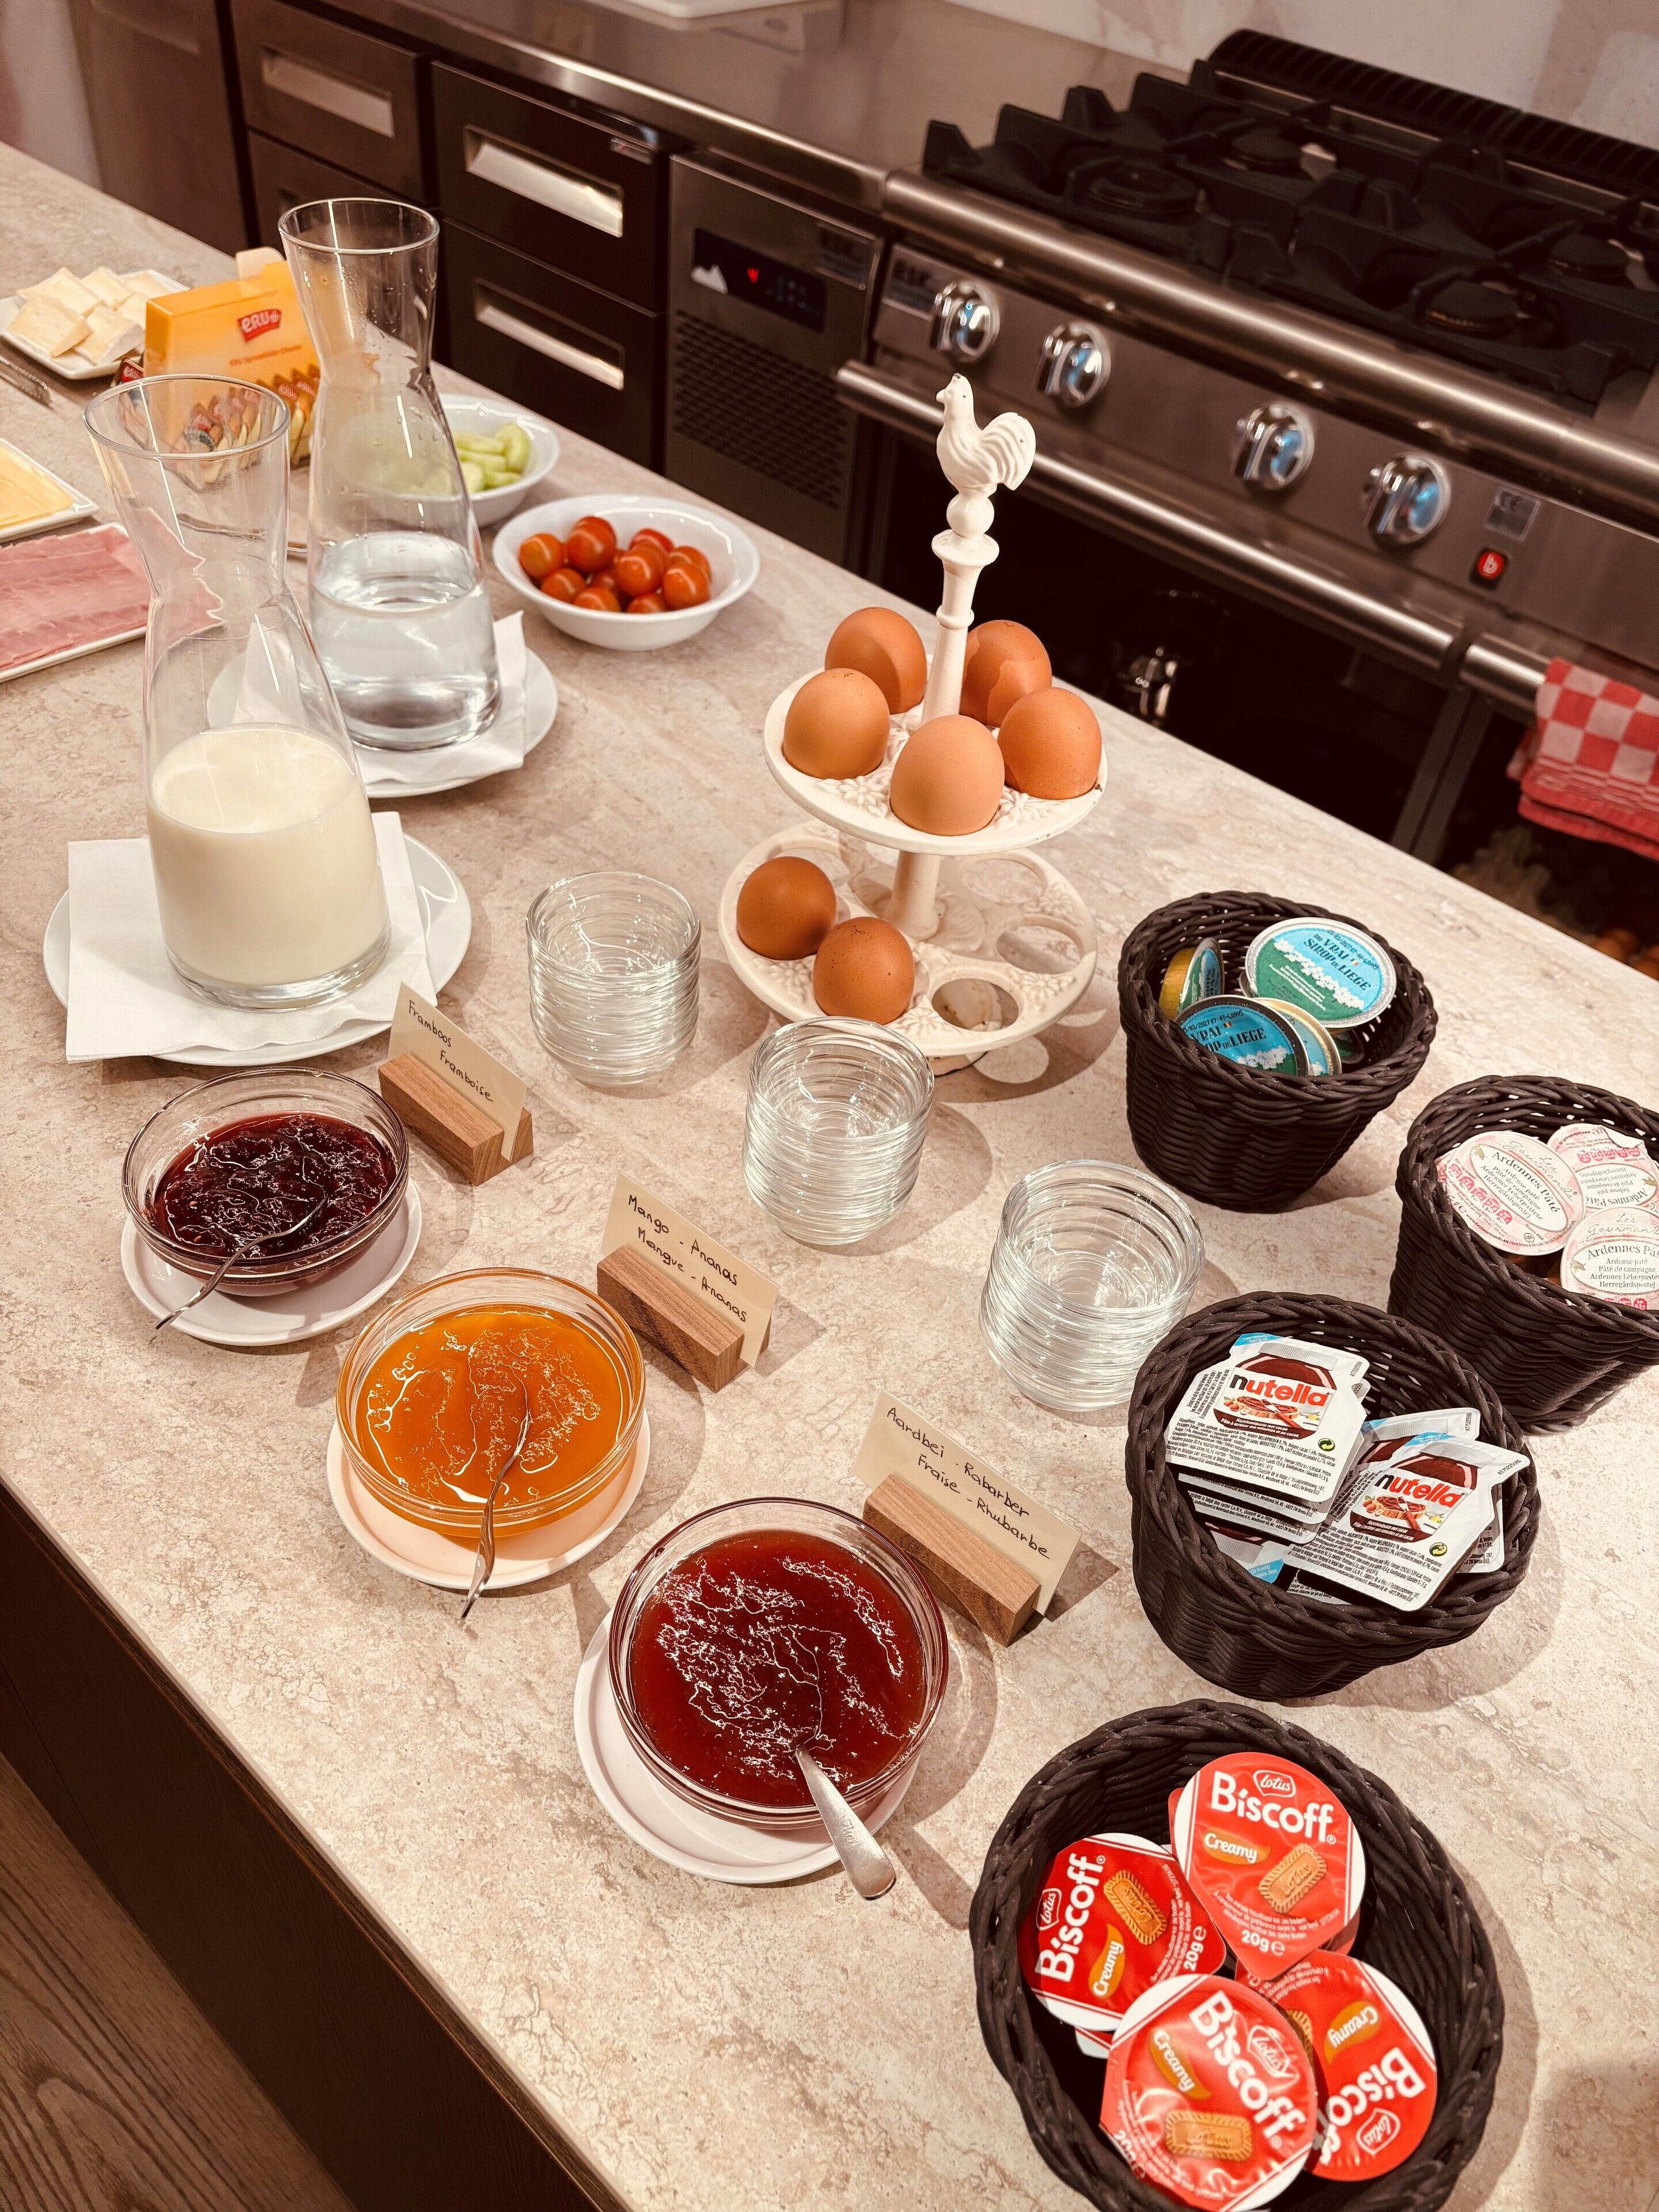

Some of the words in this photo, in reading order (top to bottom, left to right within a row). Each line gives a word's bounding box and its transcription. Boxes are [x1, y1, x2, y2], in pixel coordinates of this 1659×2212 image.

[1303, 938, 1335, 964] SIROP
[1338, 964, 1372, 991] LIEGE
[1323, 938, 1350, 960] VRAI
[408, 999, 452, 1047] Framboos
[1229, 1028, 1267, 1047] LIEGE
[440, 1049, 494, 1103] Framboise
[1480, 1165, 1509, 1191] Ardenner
[1491, 1152, 1542, 1190] Ardennes
[1540, 1185, 1560, 1213] Pâté
[1493, 1166, 1507, 1180] Pâté
[1506, 1177, 1514, 1185] de
[1512, 1183, 1541, 1211] campagne
[1503, 1167, 1528, 1191] Ardense
[628, 1194, 669, 1234] Mango
[691, 1238, 738, 1286] Ananas
[1588, 1245, 1641, 1260] Ardennes
[638, 1226, 685, 1272] Mangue
[701, 1276, 748, 1323] Ananas
[1590, 1272, 1622, 1281] Ardenner
[1623, 1266, 1657, 1274] campagne
[1229, 1374, 1330, 1407] nutella
[887, 1407, 945, 1458] Aardbei
[963, 1462, 1030, 1517] Rabarber
[918, 1453, 961, 1494] Fraise
[976, 1497, 1051, 1560] Rhubarbe
[1374, 1474, 1464, 1508] nutella
[1260, 1773, 1291, 1793] Lotus
[1211, 1770, 1335, 1842] Biscoff
[1205, 1832, 1259, 1864] Creamy
[1035, 1853, 1103, 1982] Biscoff
[1040, 1892, 1056, 1925] Lotus
[1184, 1940, 1204, 1971] 20g
[1241, 1929, 1270, 1953] 20g
[1093, 1940, 1124, 1997] Creamy
[1327, 2006, 1378, 2048] Creamy
[1154, 2030, 1195, 2092] Creamy
[1190, 1990, 1306, 2138] Biscoff
[1252, 2037, 1283, 2070] Lotus
[1363, 2114, 1391, 2146] Lotus
